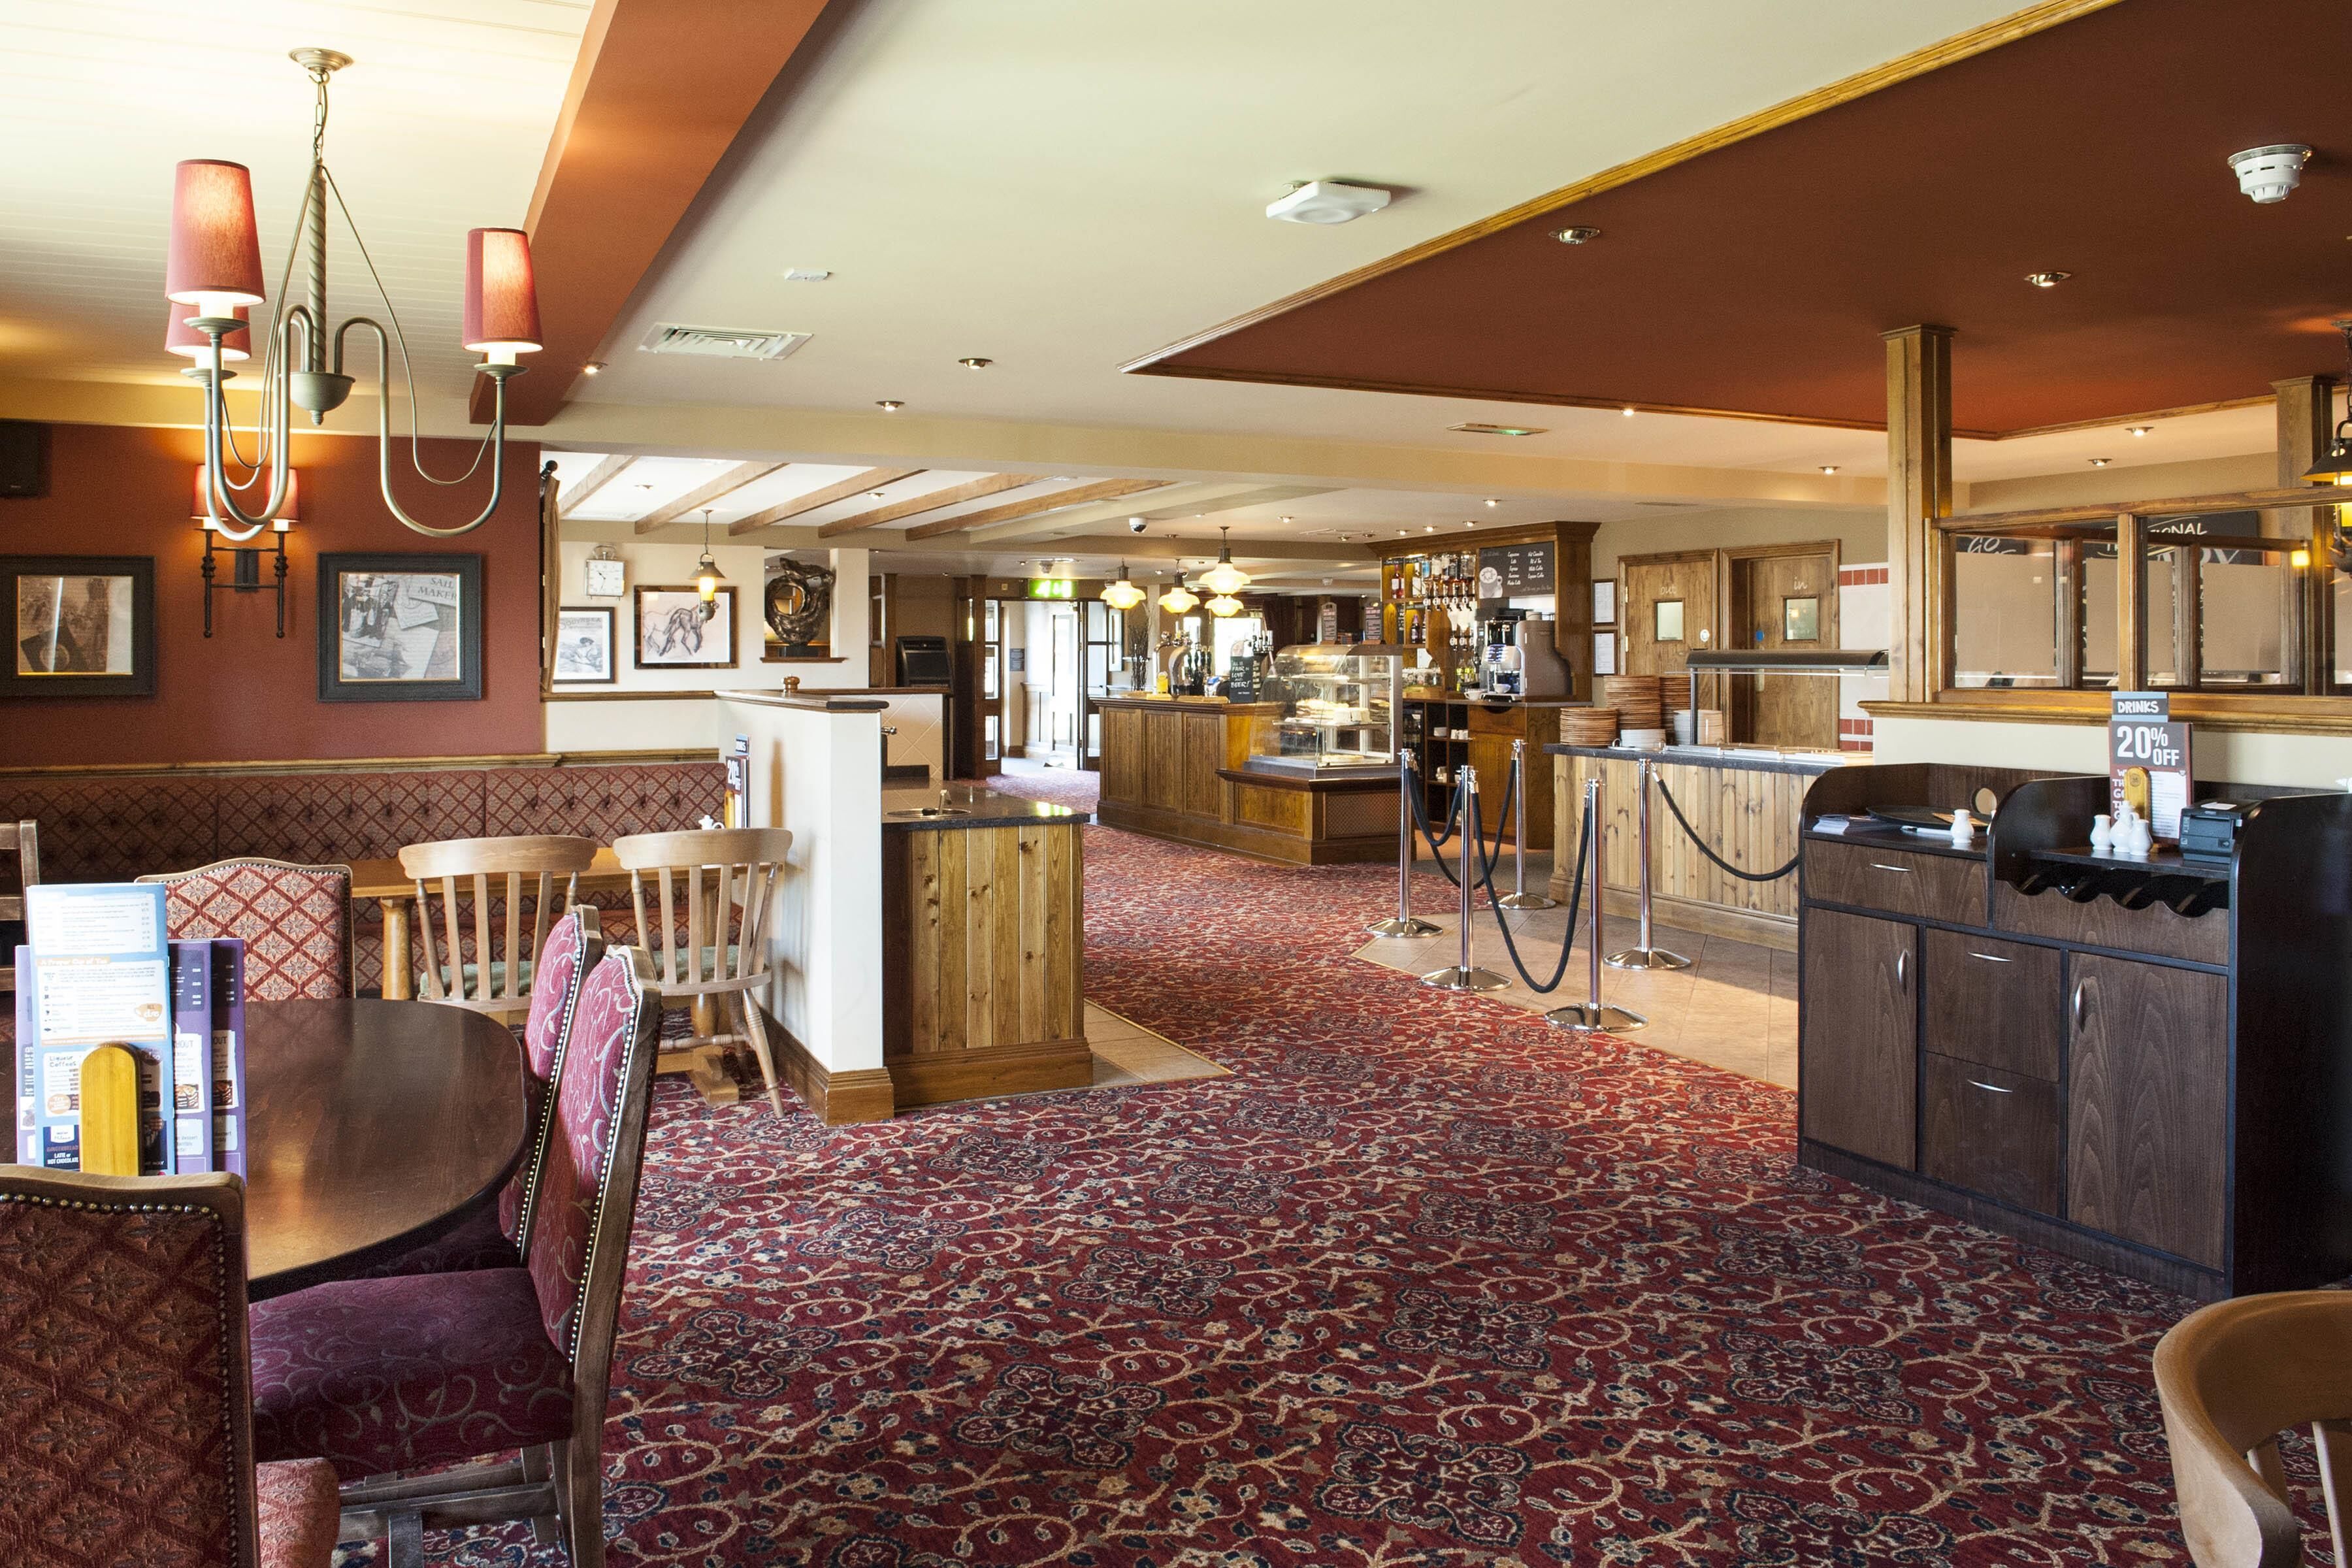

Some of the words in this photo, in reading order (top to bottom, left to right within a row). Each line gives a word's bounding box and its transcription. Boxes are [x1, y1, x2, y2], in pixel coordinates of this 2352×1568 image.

[431, 578, 453, 589] SAIL
[1660, 584, 1677, 595] out
[1793, 576, 1808, 591] in
[2117, 700, 2159, 714] DRINKS
[2117, 726, 2168, 759] 20%
[2153, 748, 2180, 766] OFF
